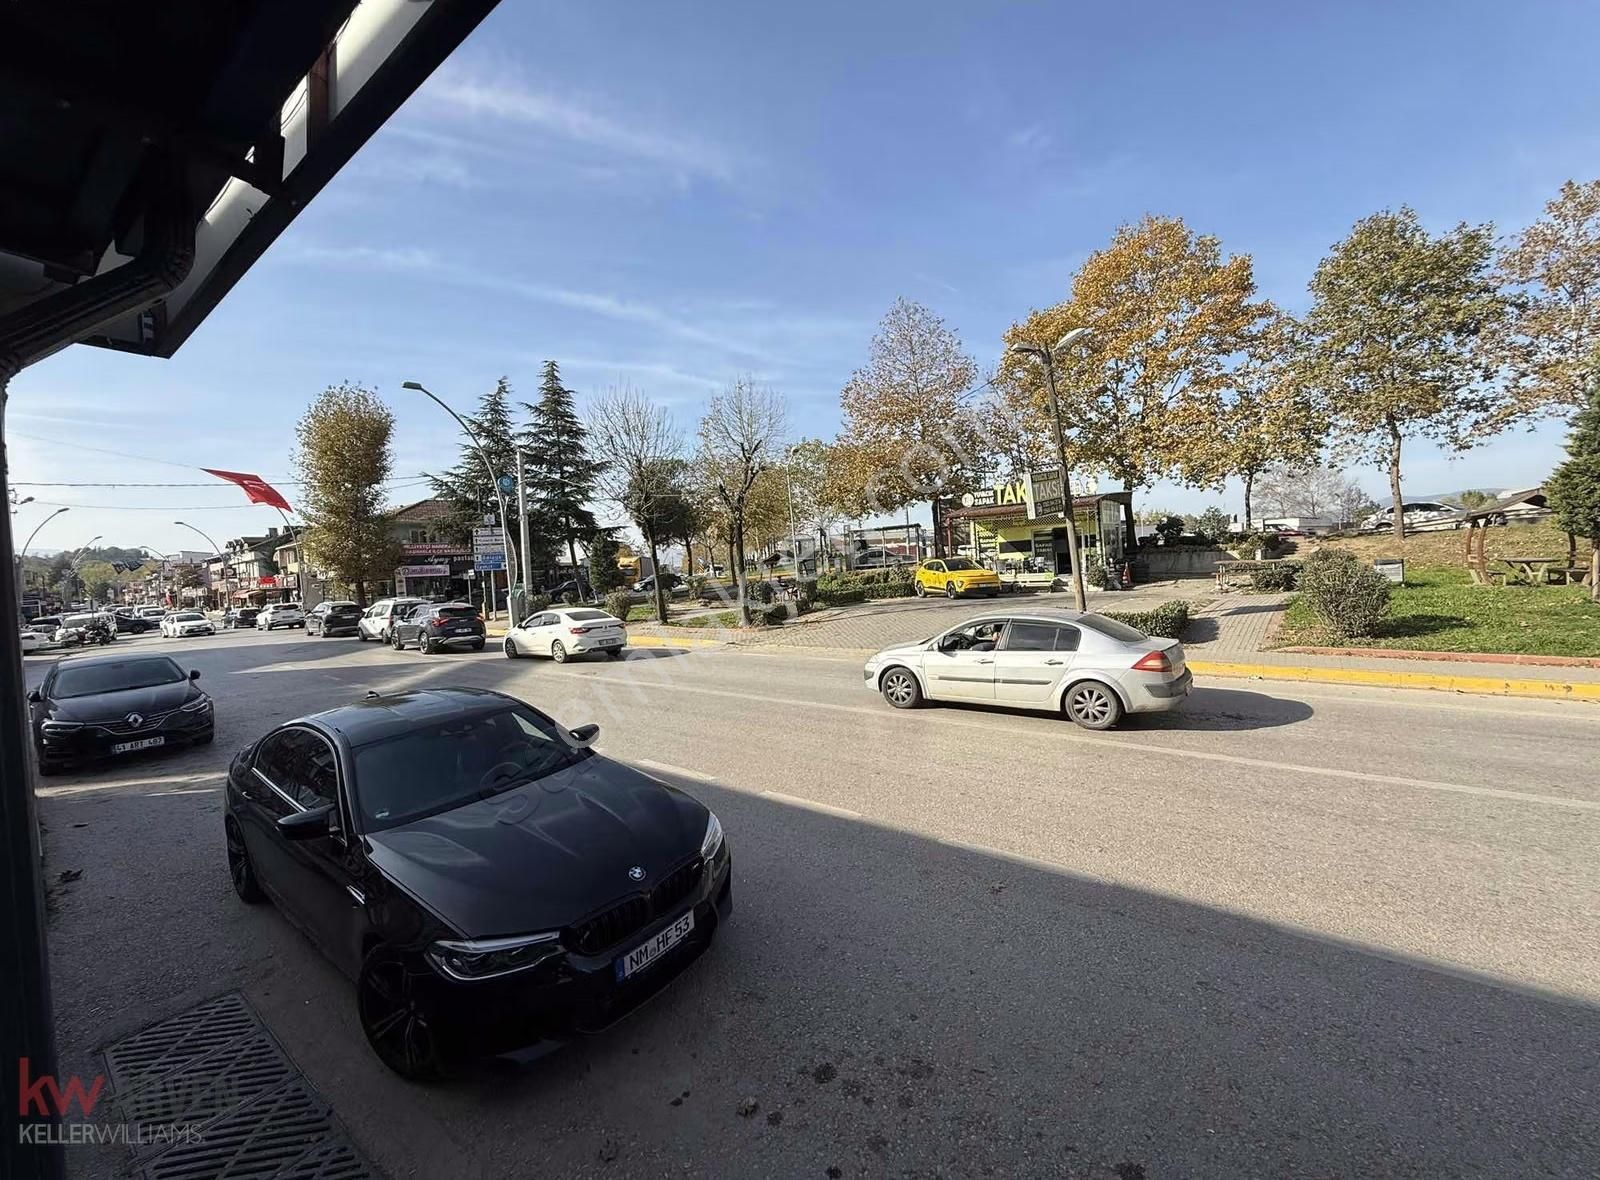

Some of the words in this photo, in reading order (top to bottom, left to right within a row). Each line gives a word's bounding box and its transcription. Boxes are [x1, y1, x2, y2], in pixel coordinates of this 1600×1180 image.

[629, 945, 649, 970] NM
[656, 926, 673, 952] HF
[674, 915, 690, 938] 53
